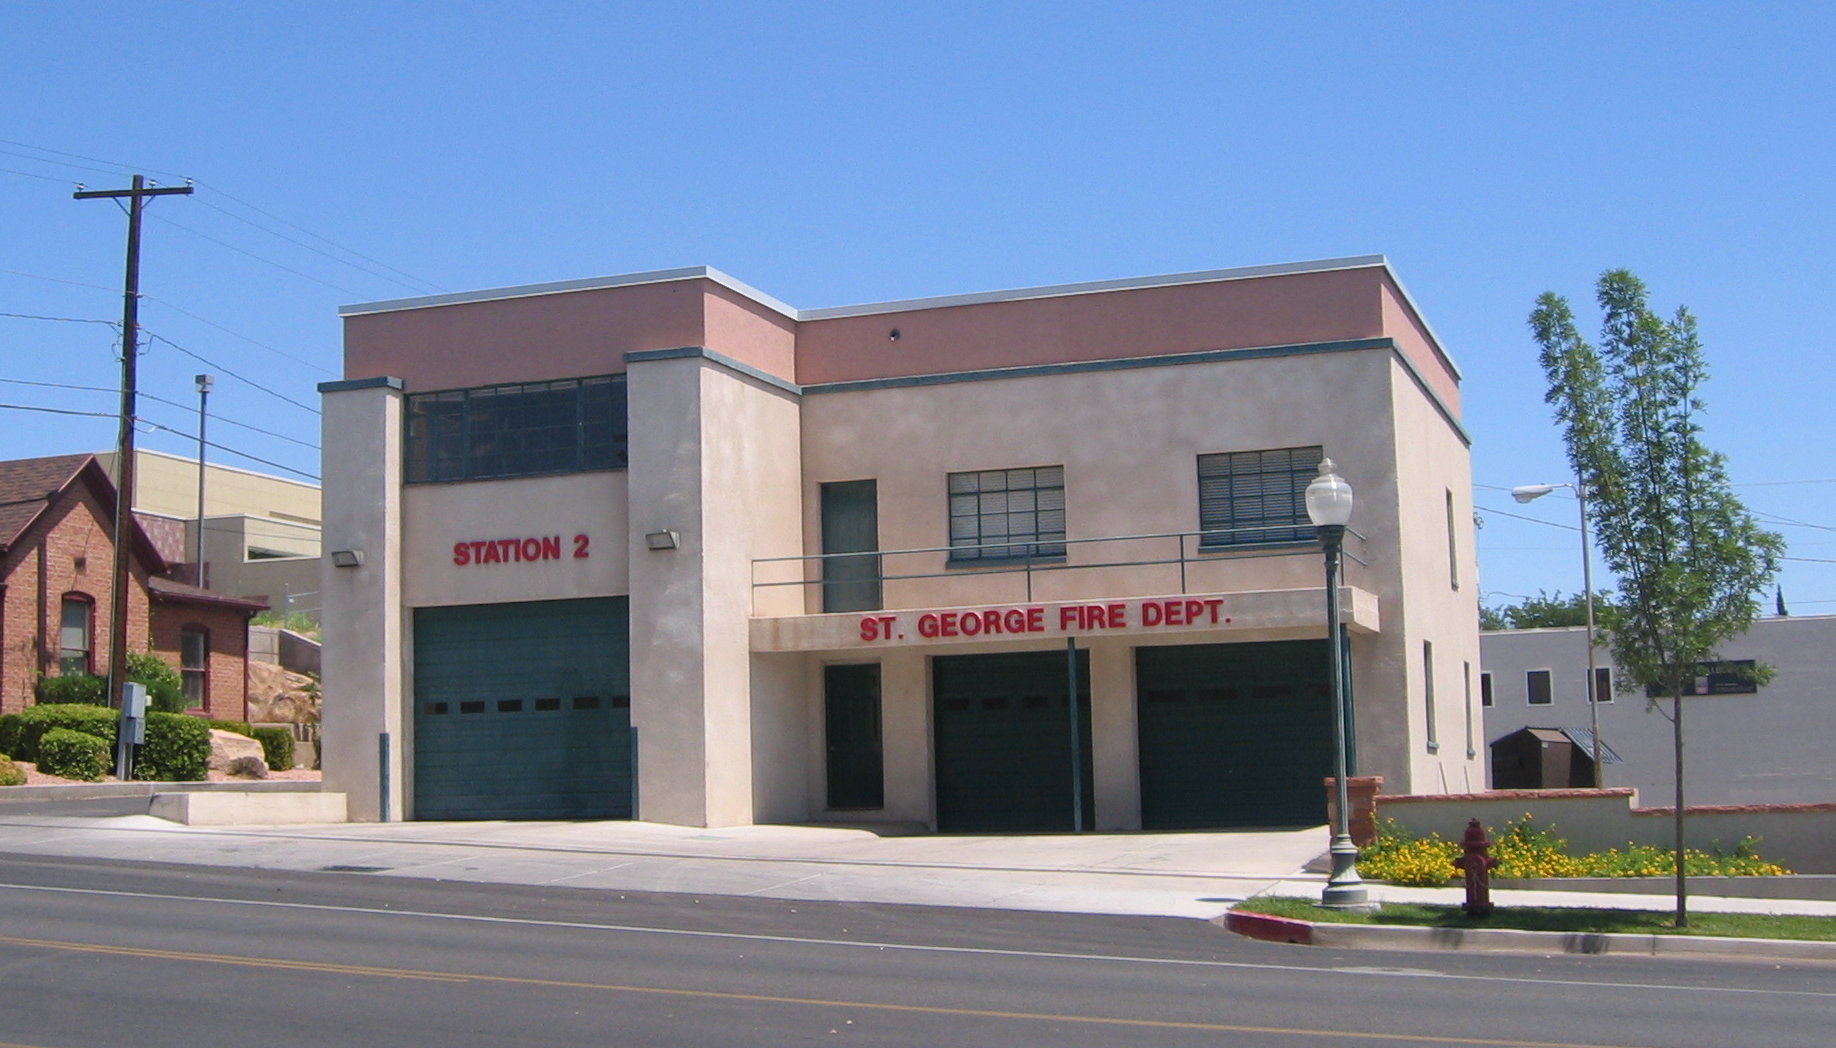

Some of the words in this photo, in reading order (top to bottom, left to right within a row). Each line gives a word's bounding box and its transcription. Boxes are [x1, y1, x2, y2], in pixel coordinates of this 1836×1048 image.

[453, 536, 560, 566] STATION
[573, 534, 590, 559] 2
[859, 616, 904, 641] ST.
[918, 608, 1046, 639] GEORGE
[1060, 603, 1127, 631] FIRE
[1142, 599, 1232, 627] DEPT.
